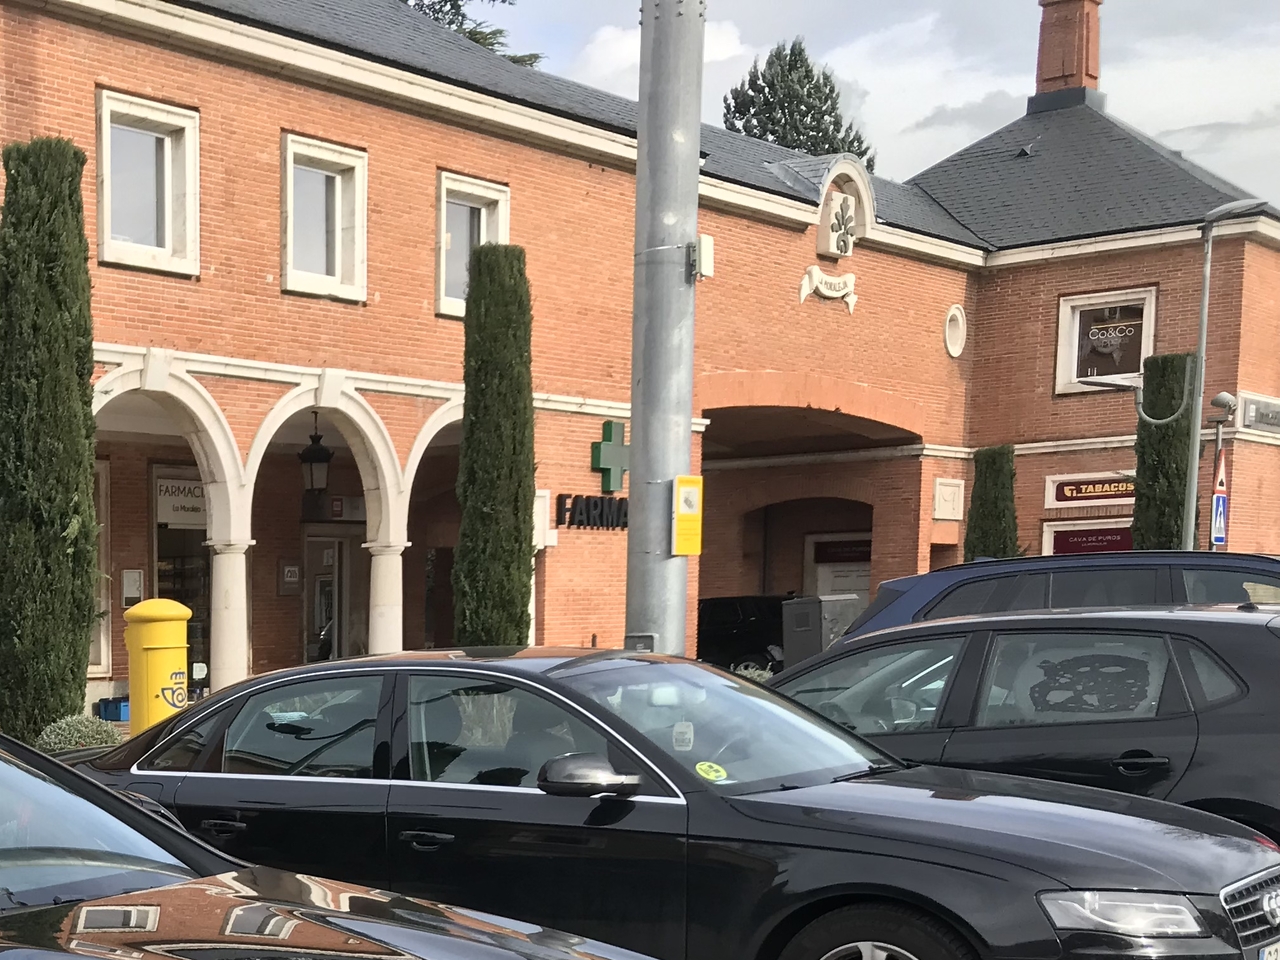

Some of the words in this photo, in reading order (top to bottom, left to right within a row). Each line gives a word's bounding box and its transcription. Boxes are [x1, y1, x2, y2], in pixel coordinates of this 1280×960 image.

[1088, 326, 1135, 339] Co&Co
[158, 484, 205, 499] FARMACI
[1080, 482, 1135, 493] TABACOS
